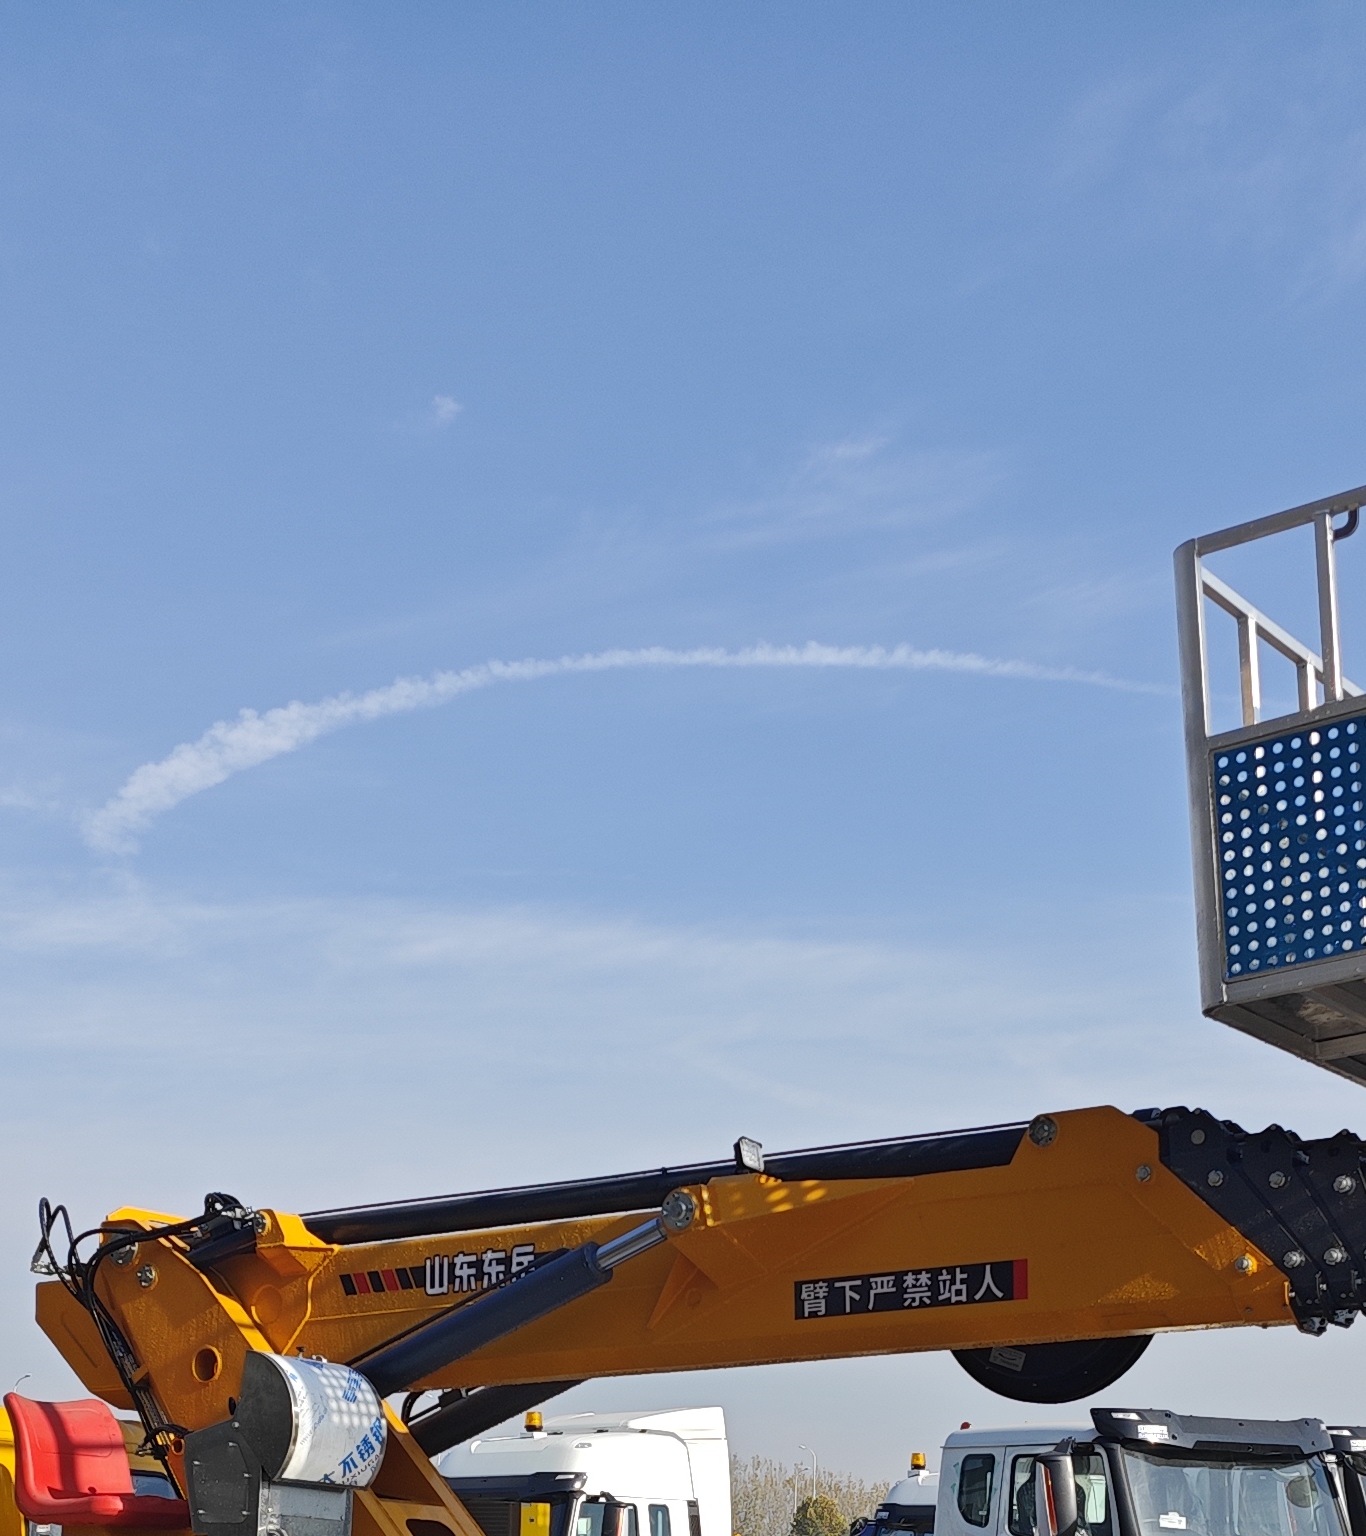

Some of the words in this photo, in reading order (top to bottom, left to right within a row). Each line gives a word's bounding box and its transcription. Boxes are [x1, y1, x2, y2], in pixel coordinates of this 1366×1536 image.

[800, 1264, 1005, 1318] 臂下严禁站人
